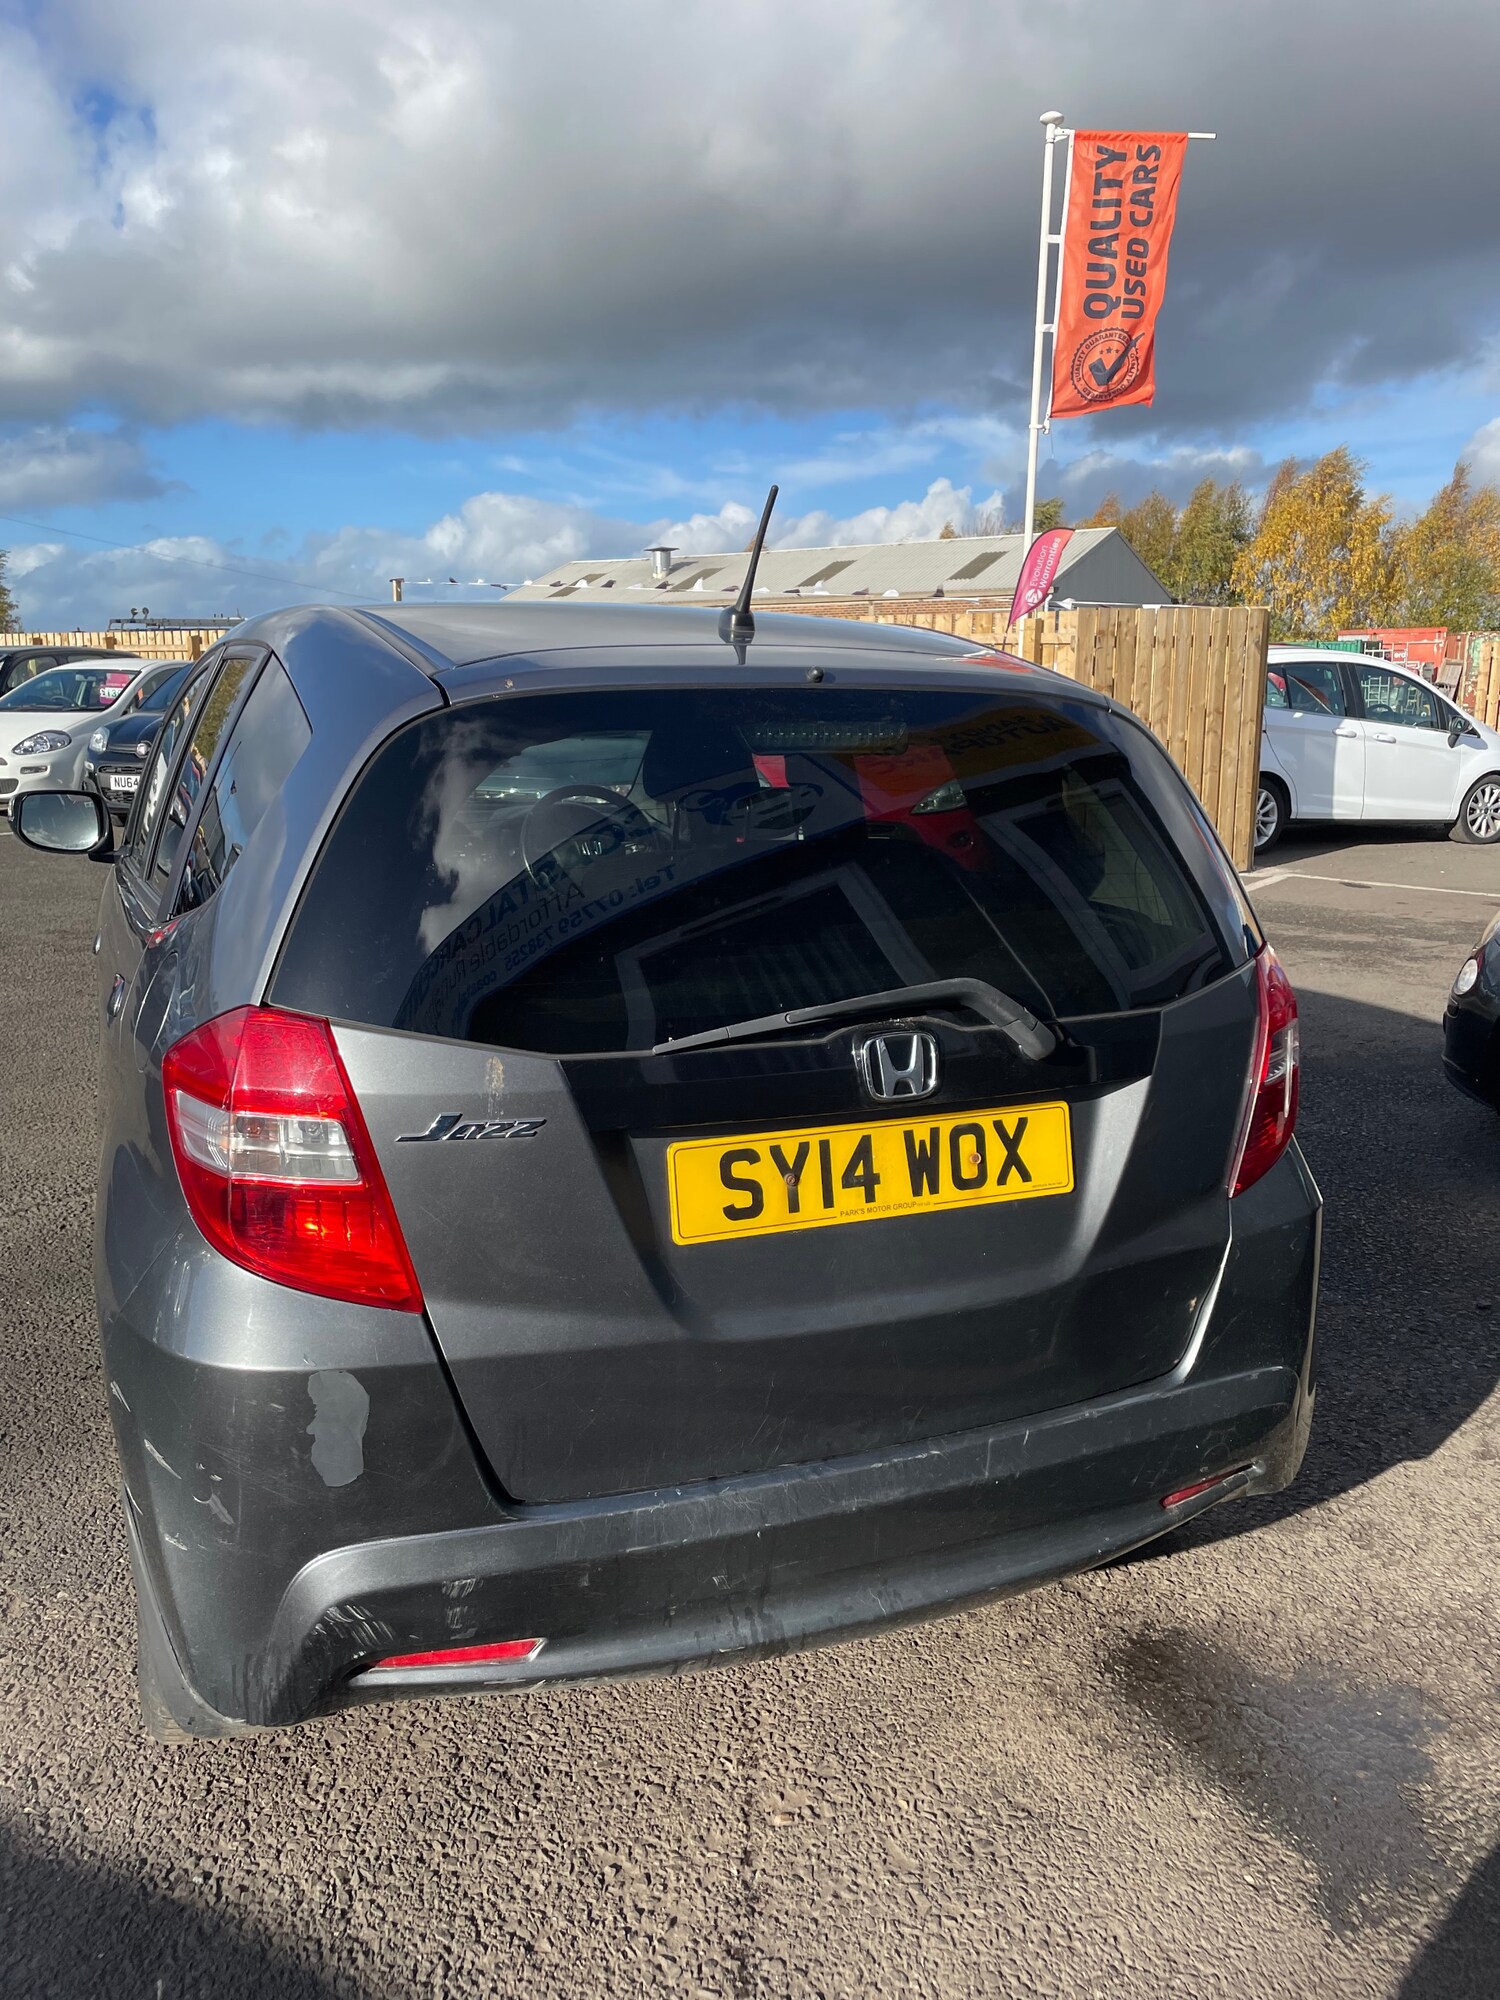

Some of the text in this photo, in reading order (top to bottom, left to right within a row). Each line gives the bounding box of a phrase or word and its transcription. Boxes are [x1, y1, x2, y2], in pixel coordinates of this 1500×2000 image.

[1083, 145, 1127, 319] QUALITY
[1121, 145, 1161, 319] USED CARS
[1074, 350, 1086, 382] QUALITY
[1030, 545, 1048, 587] Evolution
[1039, 537, 1061, 589] Warranties
[395, 1111, 548, 1143] Jazz
[719, 1117, 1032, 1221] SY14 WOX
[840, 1208, 865, 1217] PARK'S
[867, 1204, 891, 1214] MOTOR
[893, 1202, 917, 1210] GROUP
